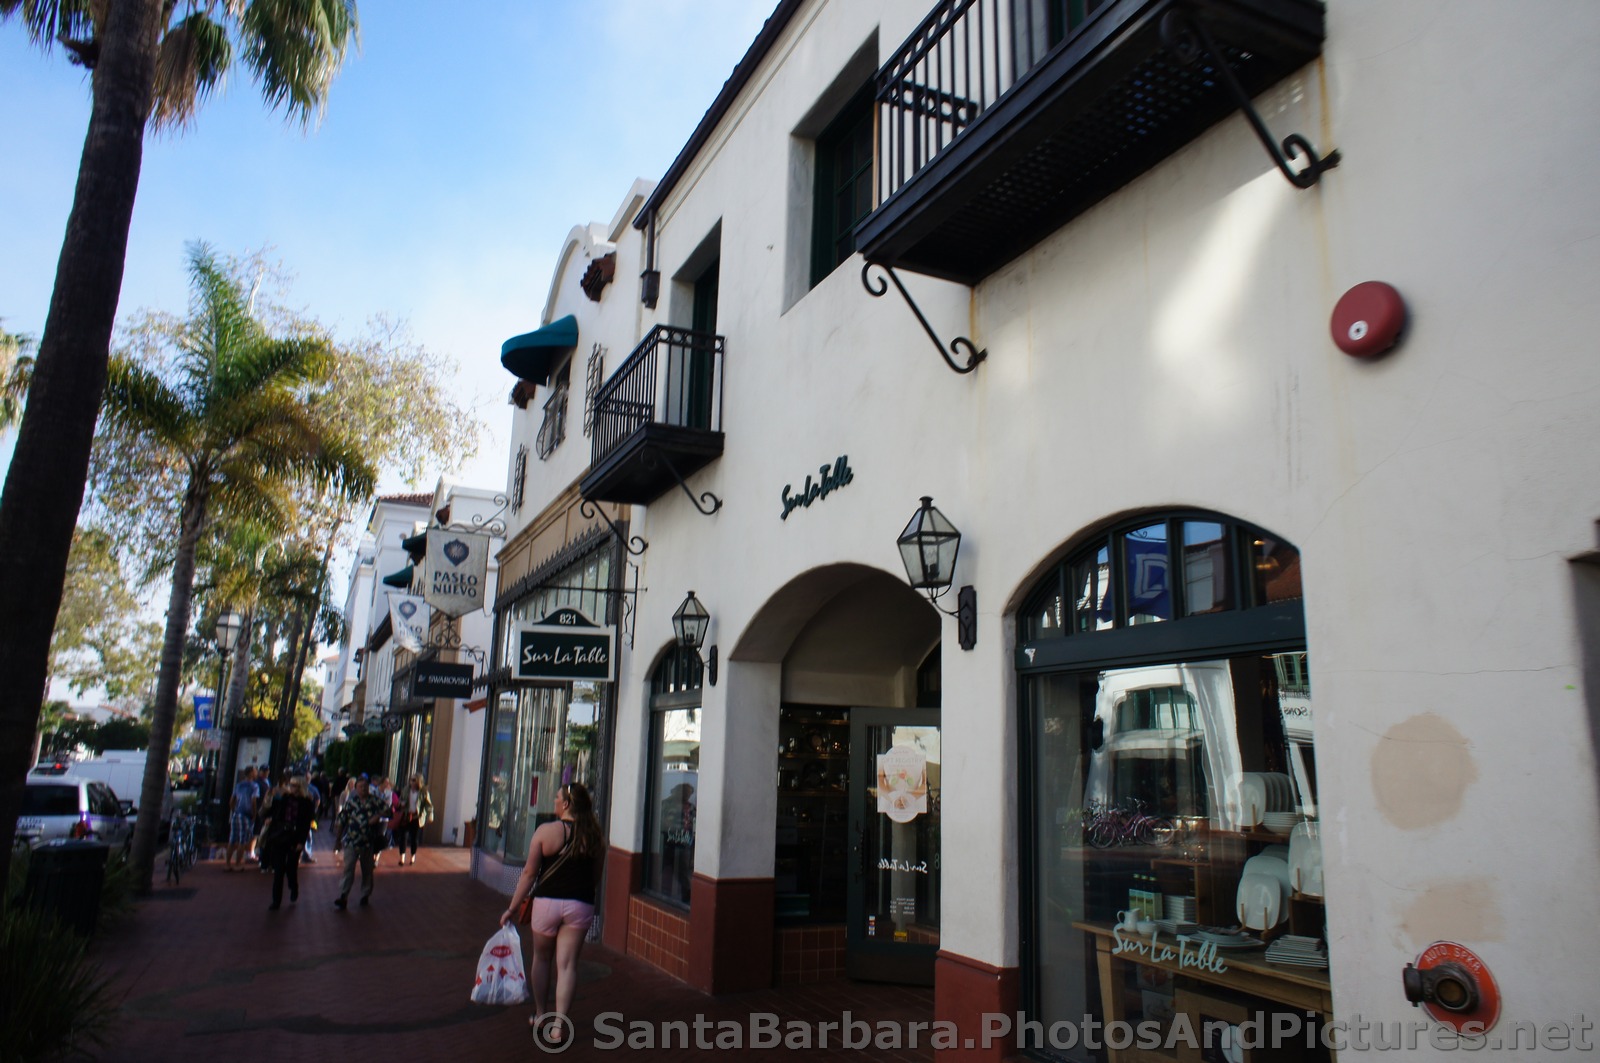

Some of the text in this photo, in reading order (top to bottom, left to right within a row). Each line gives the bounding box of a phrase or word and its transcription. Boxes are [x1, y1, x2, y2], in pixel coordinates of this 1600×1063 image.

[819, 454, 854, 501] Table
[434, 571, 478, 586] PASEO
[432, 583, 477, 598] NUEVO
[559, 613, 577, 625] 821
[522, 644, 608, 666] Sur La Table
[428, 674, 470, 685] SWAROVSKI
[1112, 924, 1228, 974] Sur La Table
[1424, 945, 1449, 963] AUTO
